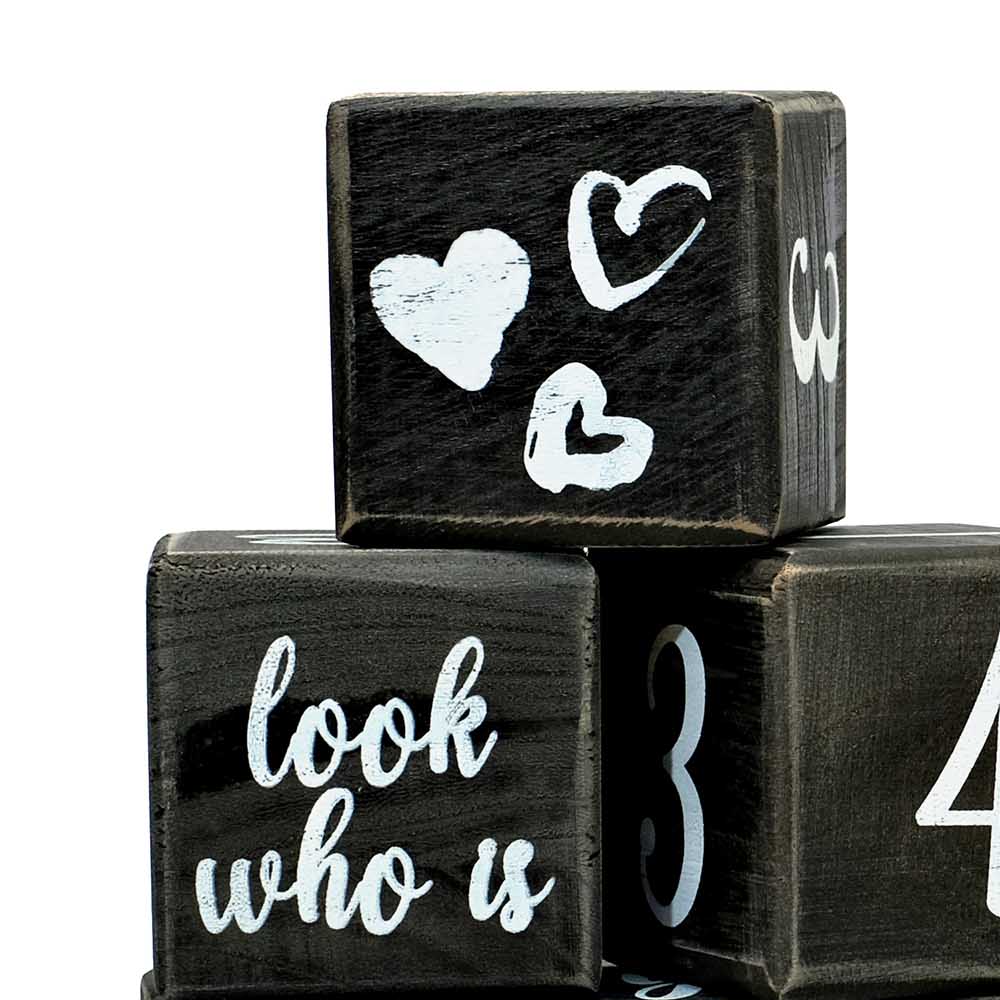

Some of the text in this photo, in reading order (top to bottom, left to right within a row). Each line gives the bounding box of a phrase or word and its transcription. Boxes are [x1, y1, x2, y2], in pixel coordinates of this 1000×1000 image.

[247, 636, 498, 788] look
[640, 624, 707, 928] 3
[195, 787, 556, 935] who is
